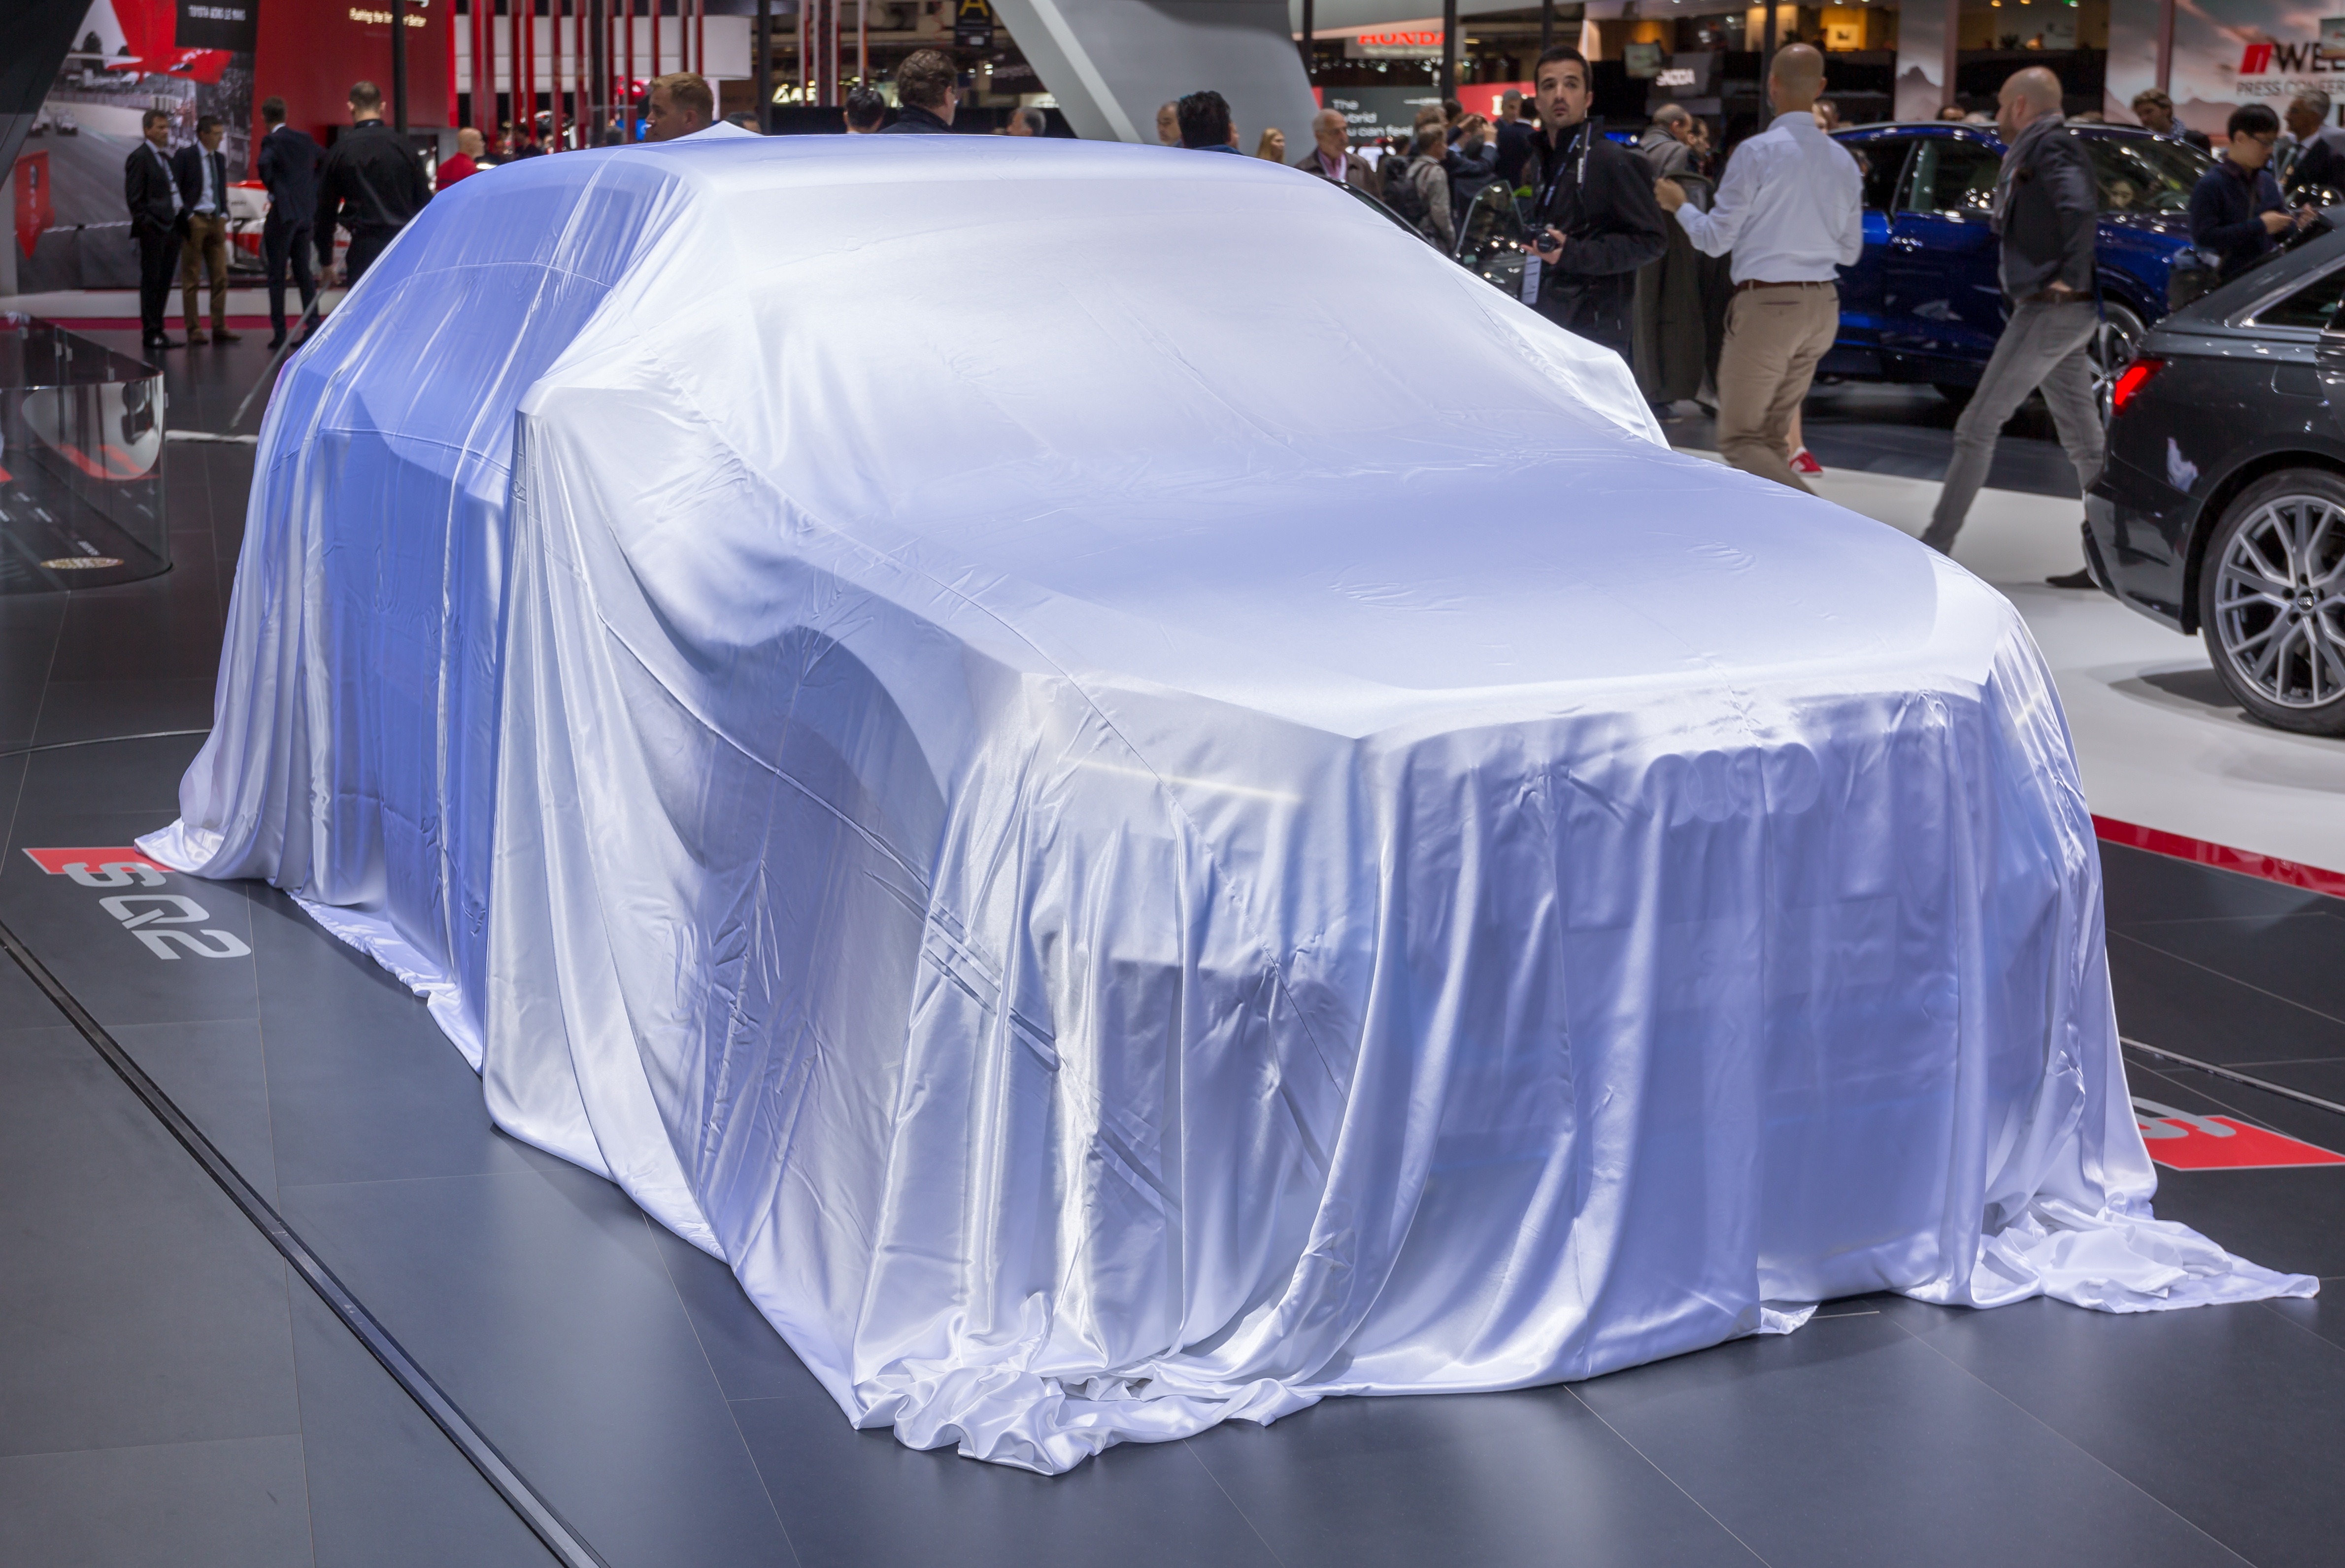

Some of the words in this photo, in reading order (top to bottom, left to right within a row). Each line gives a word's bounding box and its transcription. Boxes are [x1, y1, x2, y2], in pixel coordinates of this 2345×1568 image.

[2237, 81, 2280, 96] PRESS
[1332, 99, 1359, 110] The
[62, 862, 252, 960] SQ2
